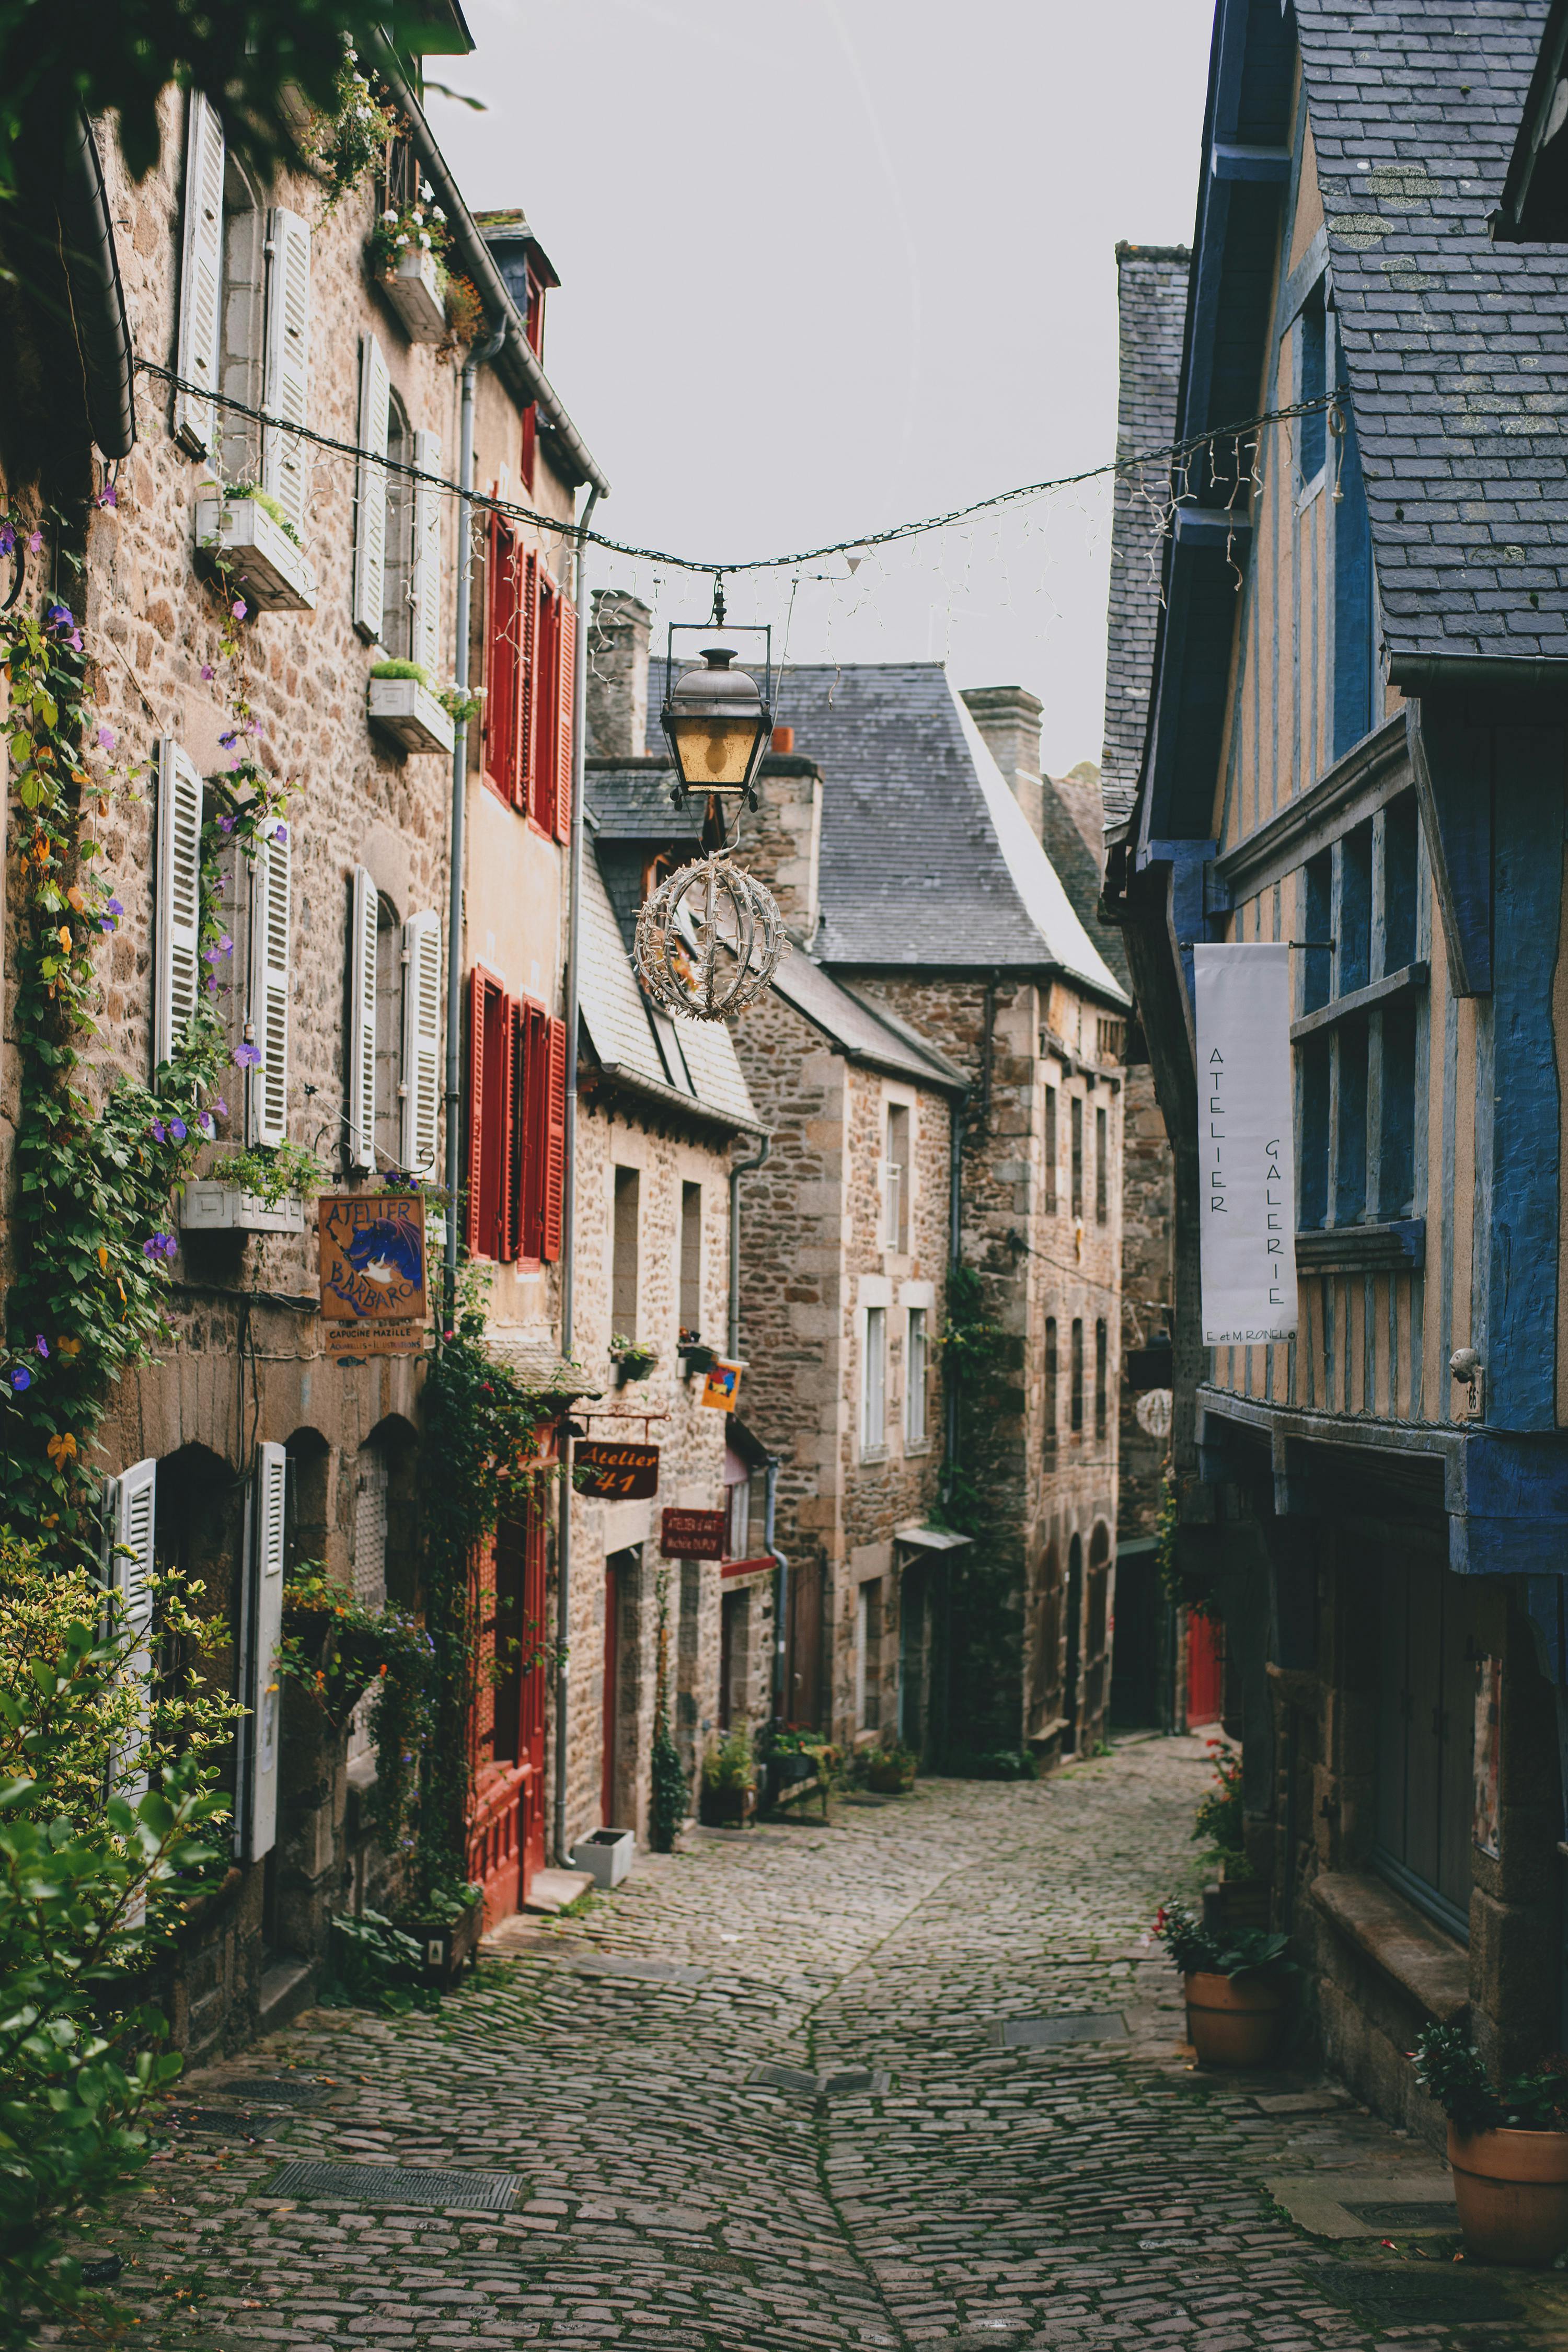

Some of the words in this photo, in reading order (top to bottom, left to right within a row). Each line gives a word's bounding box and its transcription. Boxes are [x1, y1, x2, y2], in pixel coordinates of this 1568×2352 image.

[1209, 1048, 1228, 1212] ATELIER
[328, 1202, 410, 1226] ATELIER
[1265, 1139, 1284, 1305] GALERIE
[330, 1260, 413, 1310] BARBARO
[1220, 1331, 1230, 1341] et
[1246, 1328, 1287, 1340] ROINEL
[1469, 1386, 1477, 1409] 66
[577, 1446, 656, 1467] Atelier
[594, 1471, 636, 1492] 41
